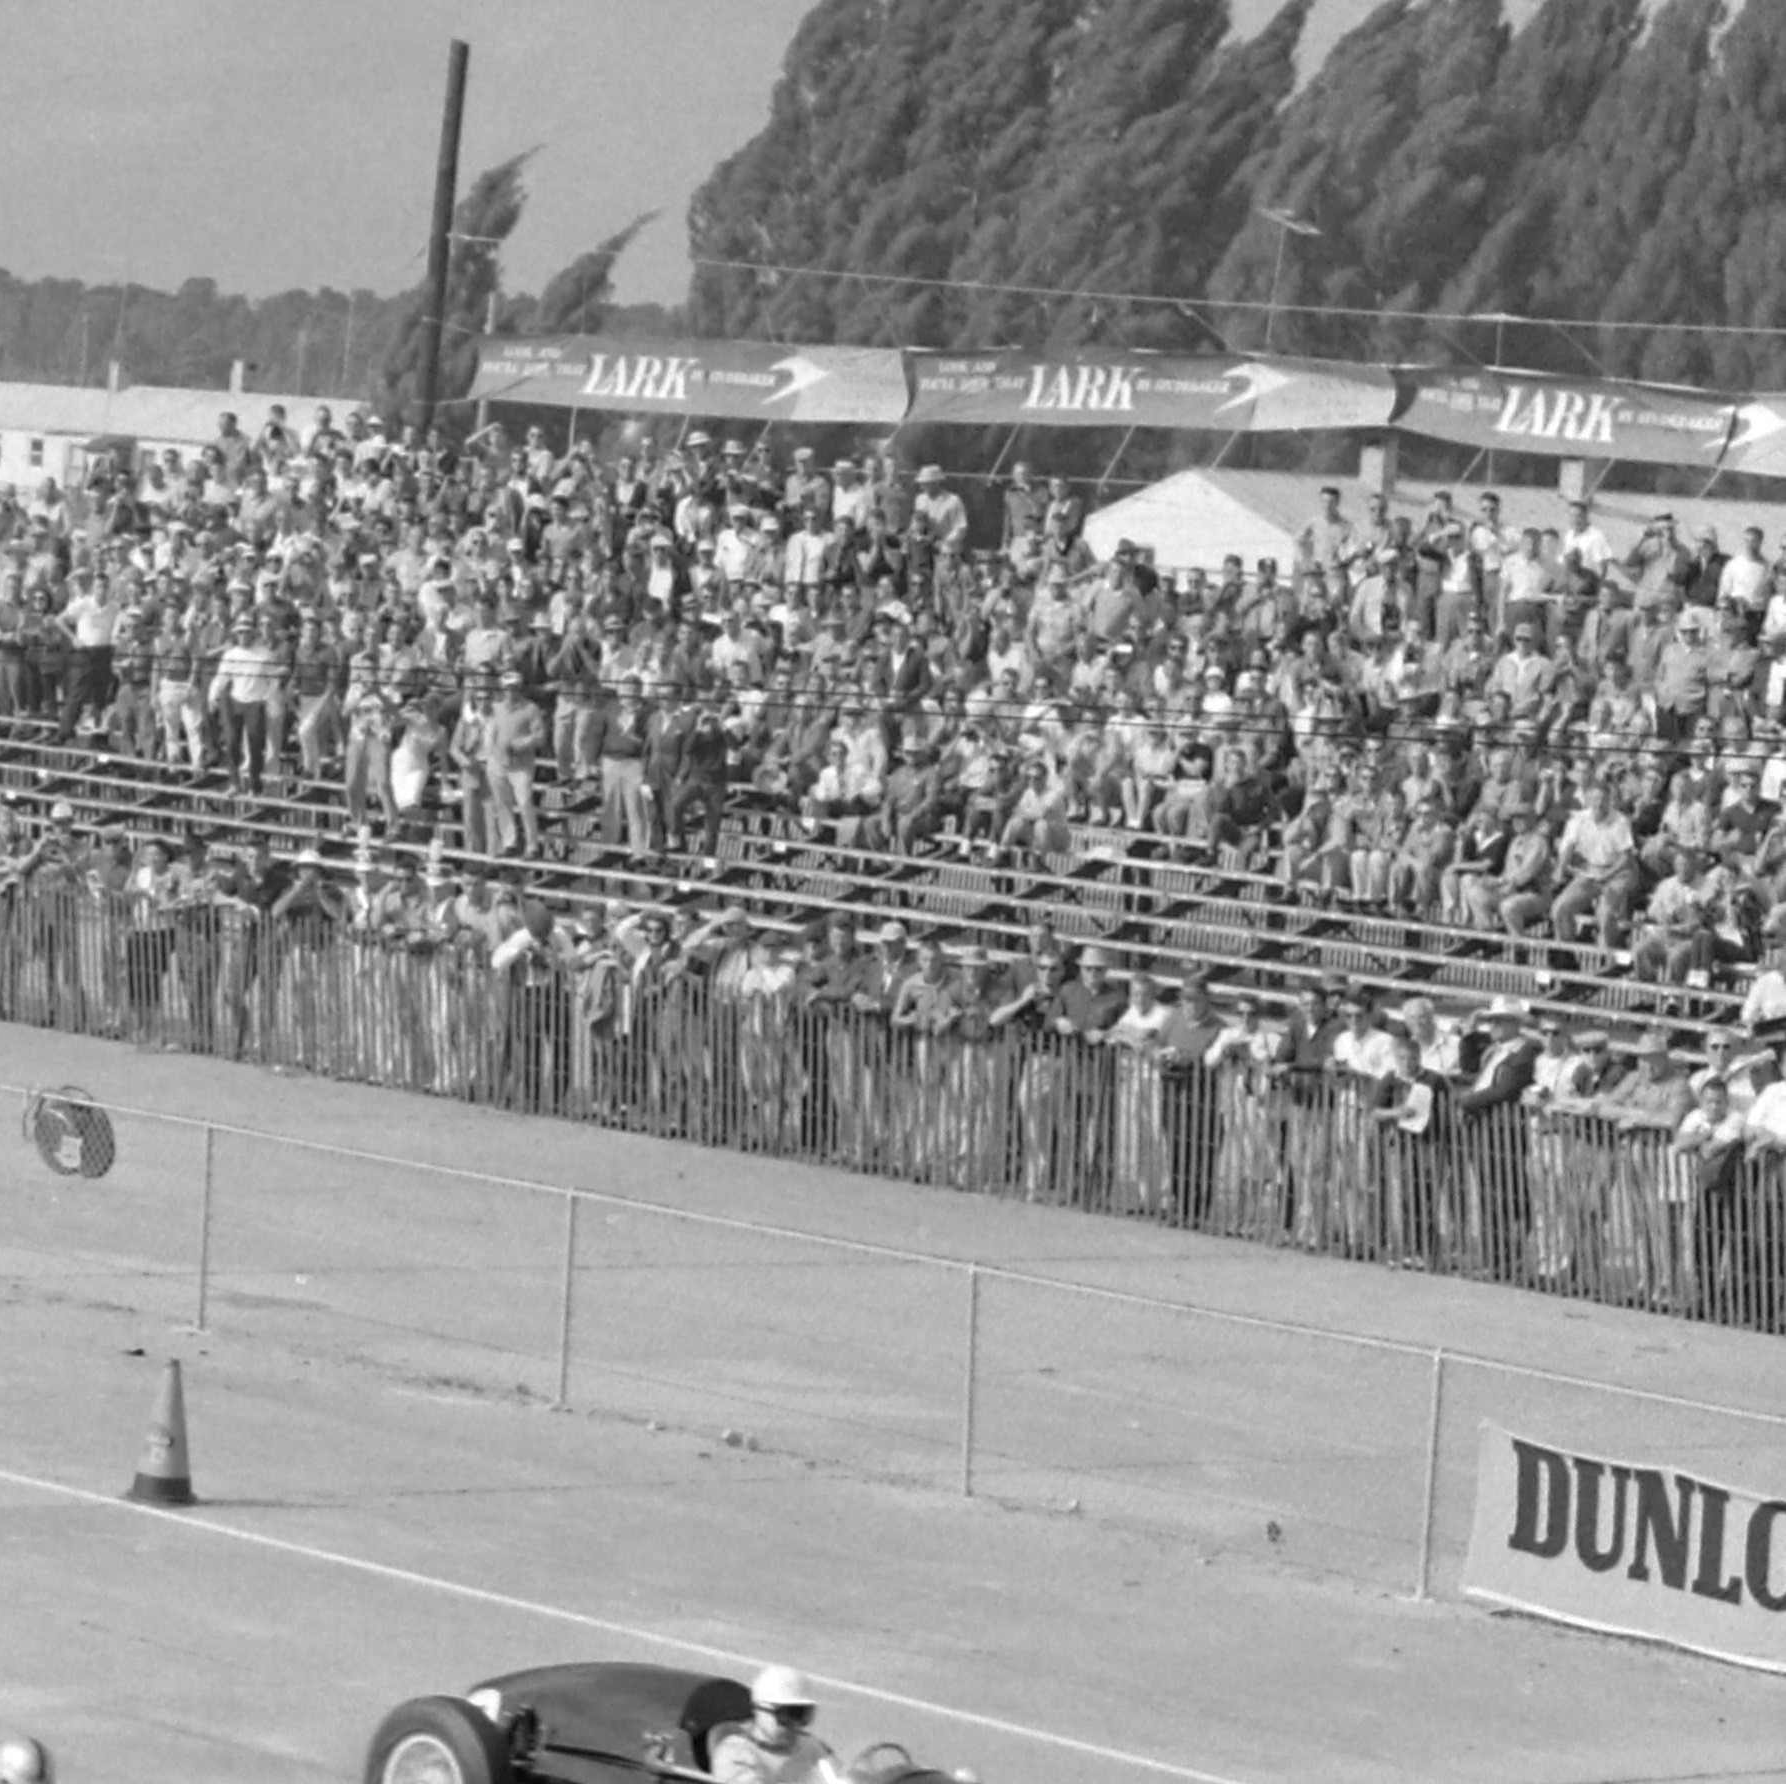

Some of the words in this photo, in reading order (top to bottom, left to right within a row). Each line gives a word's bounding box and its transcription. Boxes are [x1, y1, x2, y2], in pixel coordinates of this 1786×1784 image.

[579, 353, 700, 399] LARK
[1020, 365, 1146, 410] LARK
[1495, 386, 1624, 442] LARK
[1508, 1437, 1786, 1612] DUNLO
